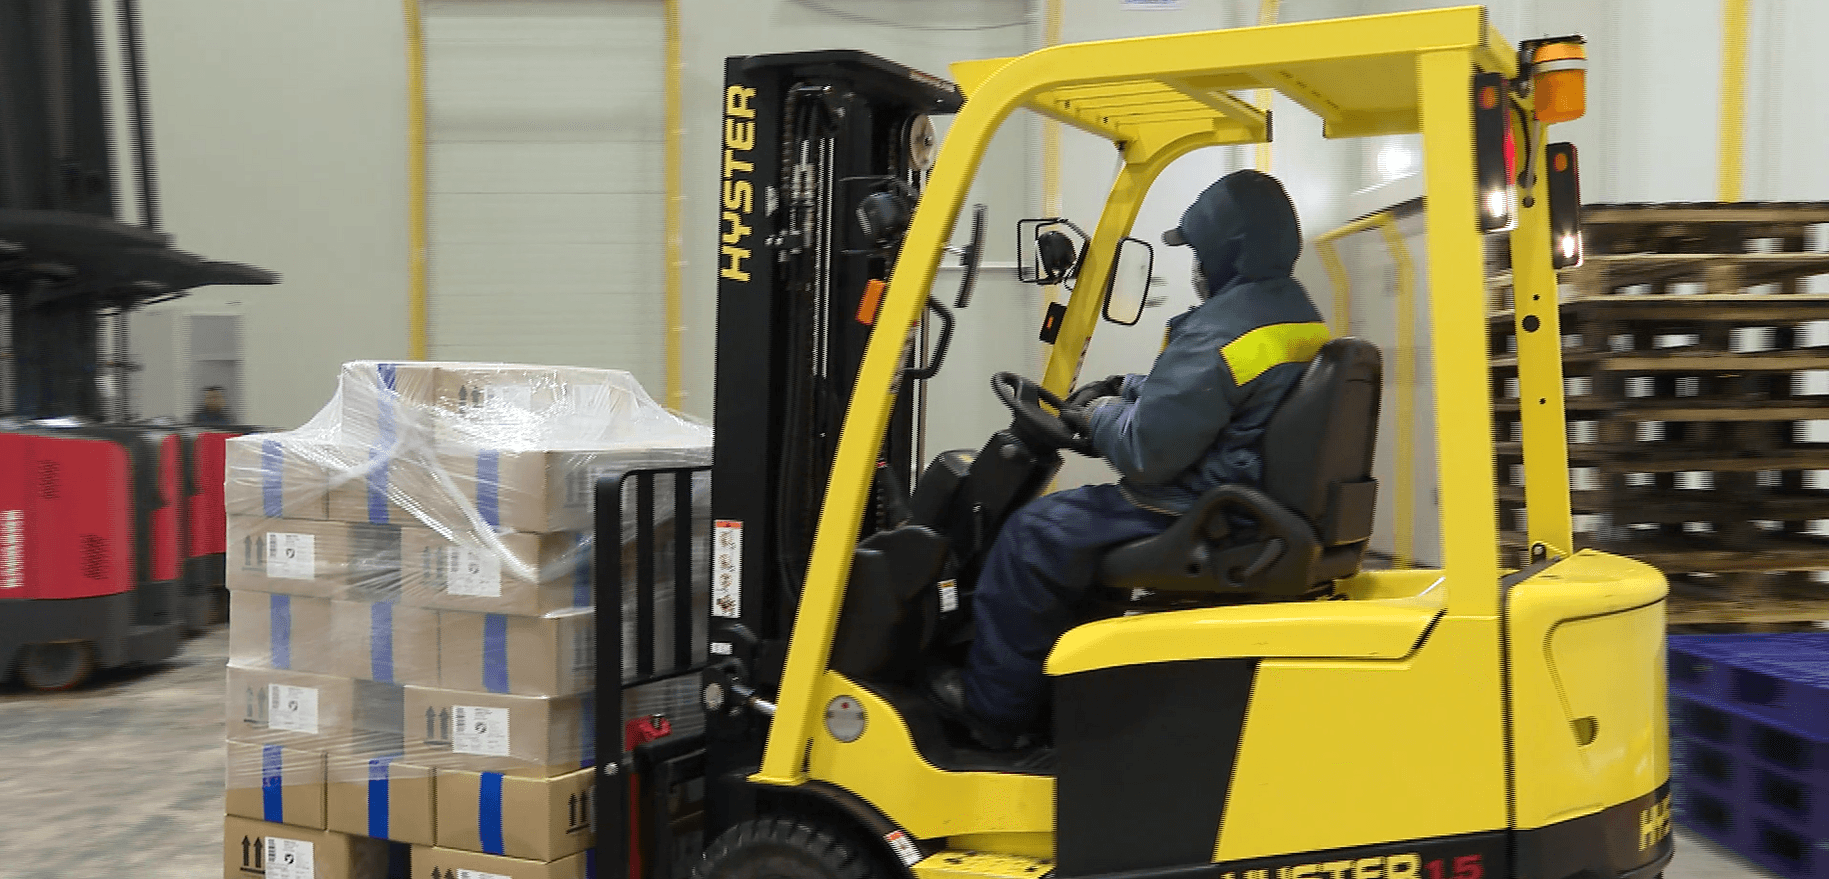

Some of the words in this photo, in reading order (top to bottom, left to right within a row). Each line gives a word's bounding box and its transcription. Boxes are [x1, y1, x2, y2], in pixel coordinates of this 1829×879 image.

[720, 84, 757, 283] HYSTER
[1220, 852, 1421, 879] TER
[1423, 854, 1484, 879] 15
